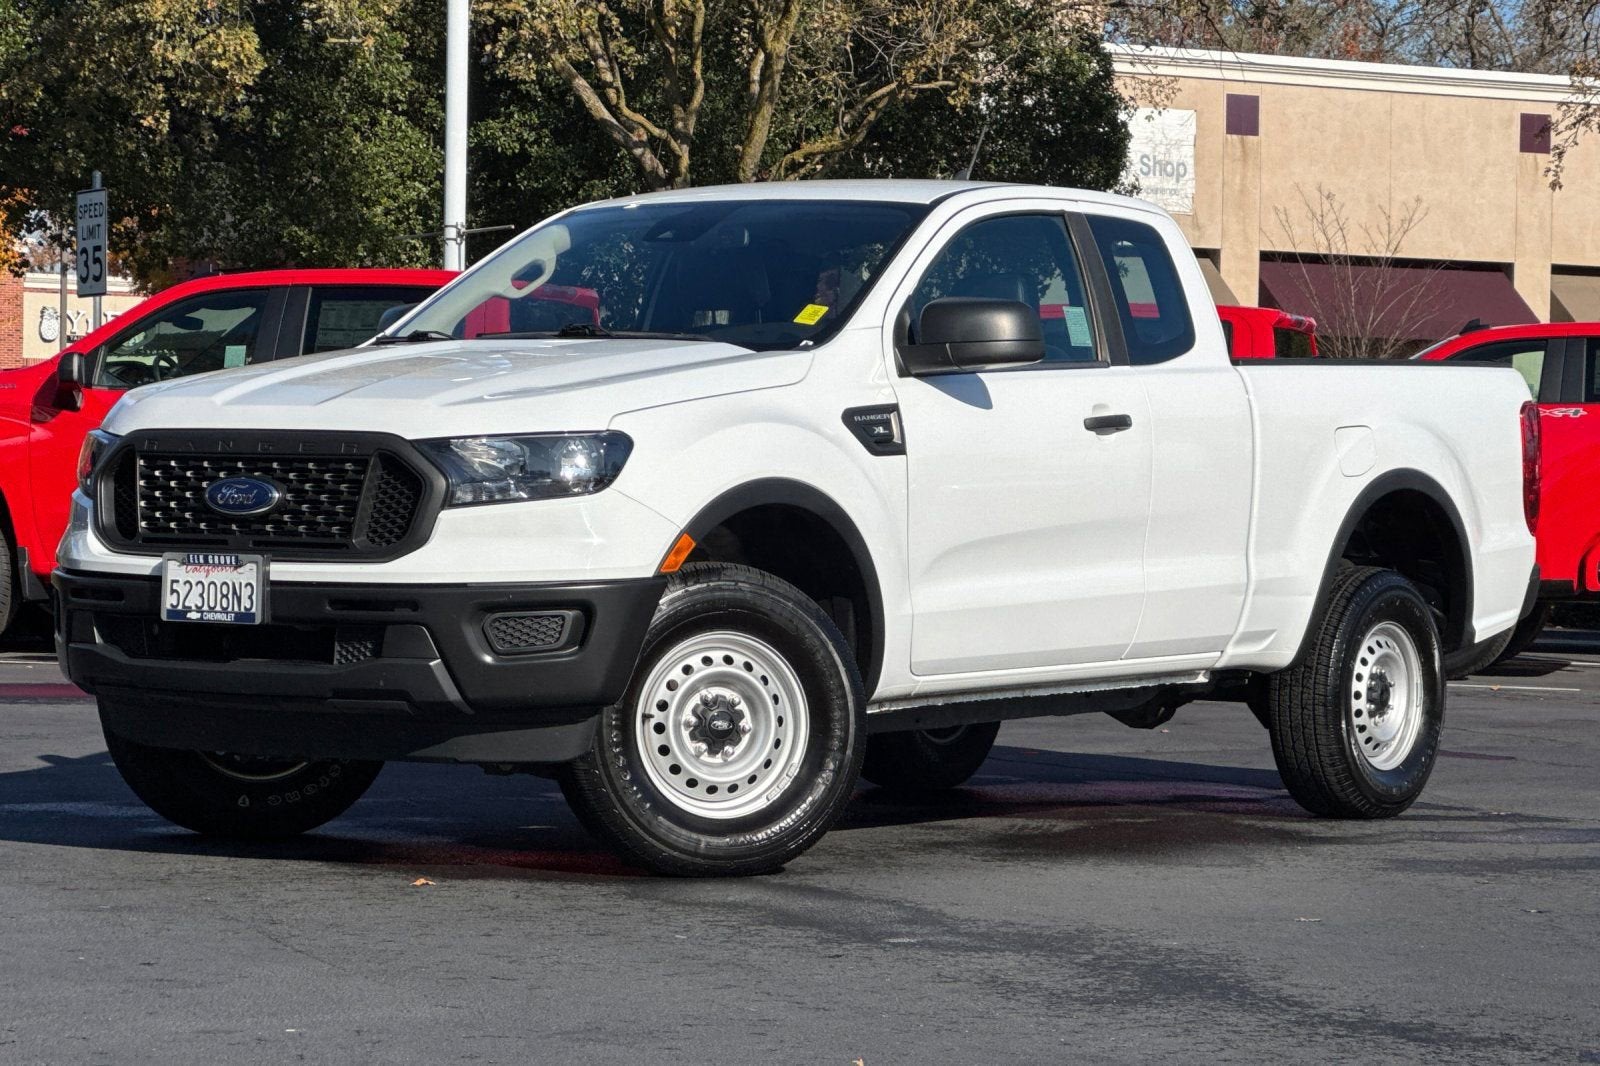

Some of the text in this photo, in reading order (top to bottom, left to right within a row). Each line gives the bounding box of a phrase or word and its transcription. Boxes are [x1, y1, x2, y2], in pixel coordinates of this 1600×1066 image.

[1139, 153, 1188, 183] Shop
[78, 201, 104, 220] SPEED
[81, 224, 101, 241] LIMIT
[79, 245, 103, 284] 35
[853, 413, 891, 422] RANGER
[871, 426, 889, 434] XL
[143, 439, 361, 455] RANGER
[216, 482, 257, 506] Ford
[189, 553, 236, 566] ELK GROVE
[169, 578, 255, 612] 52308N3
[202, 612, 235, 622] CHEVROLET
